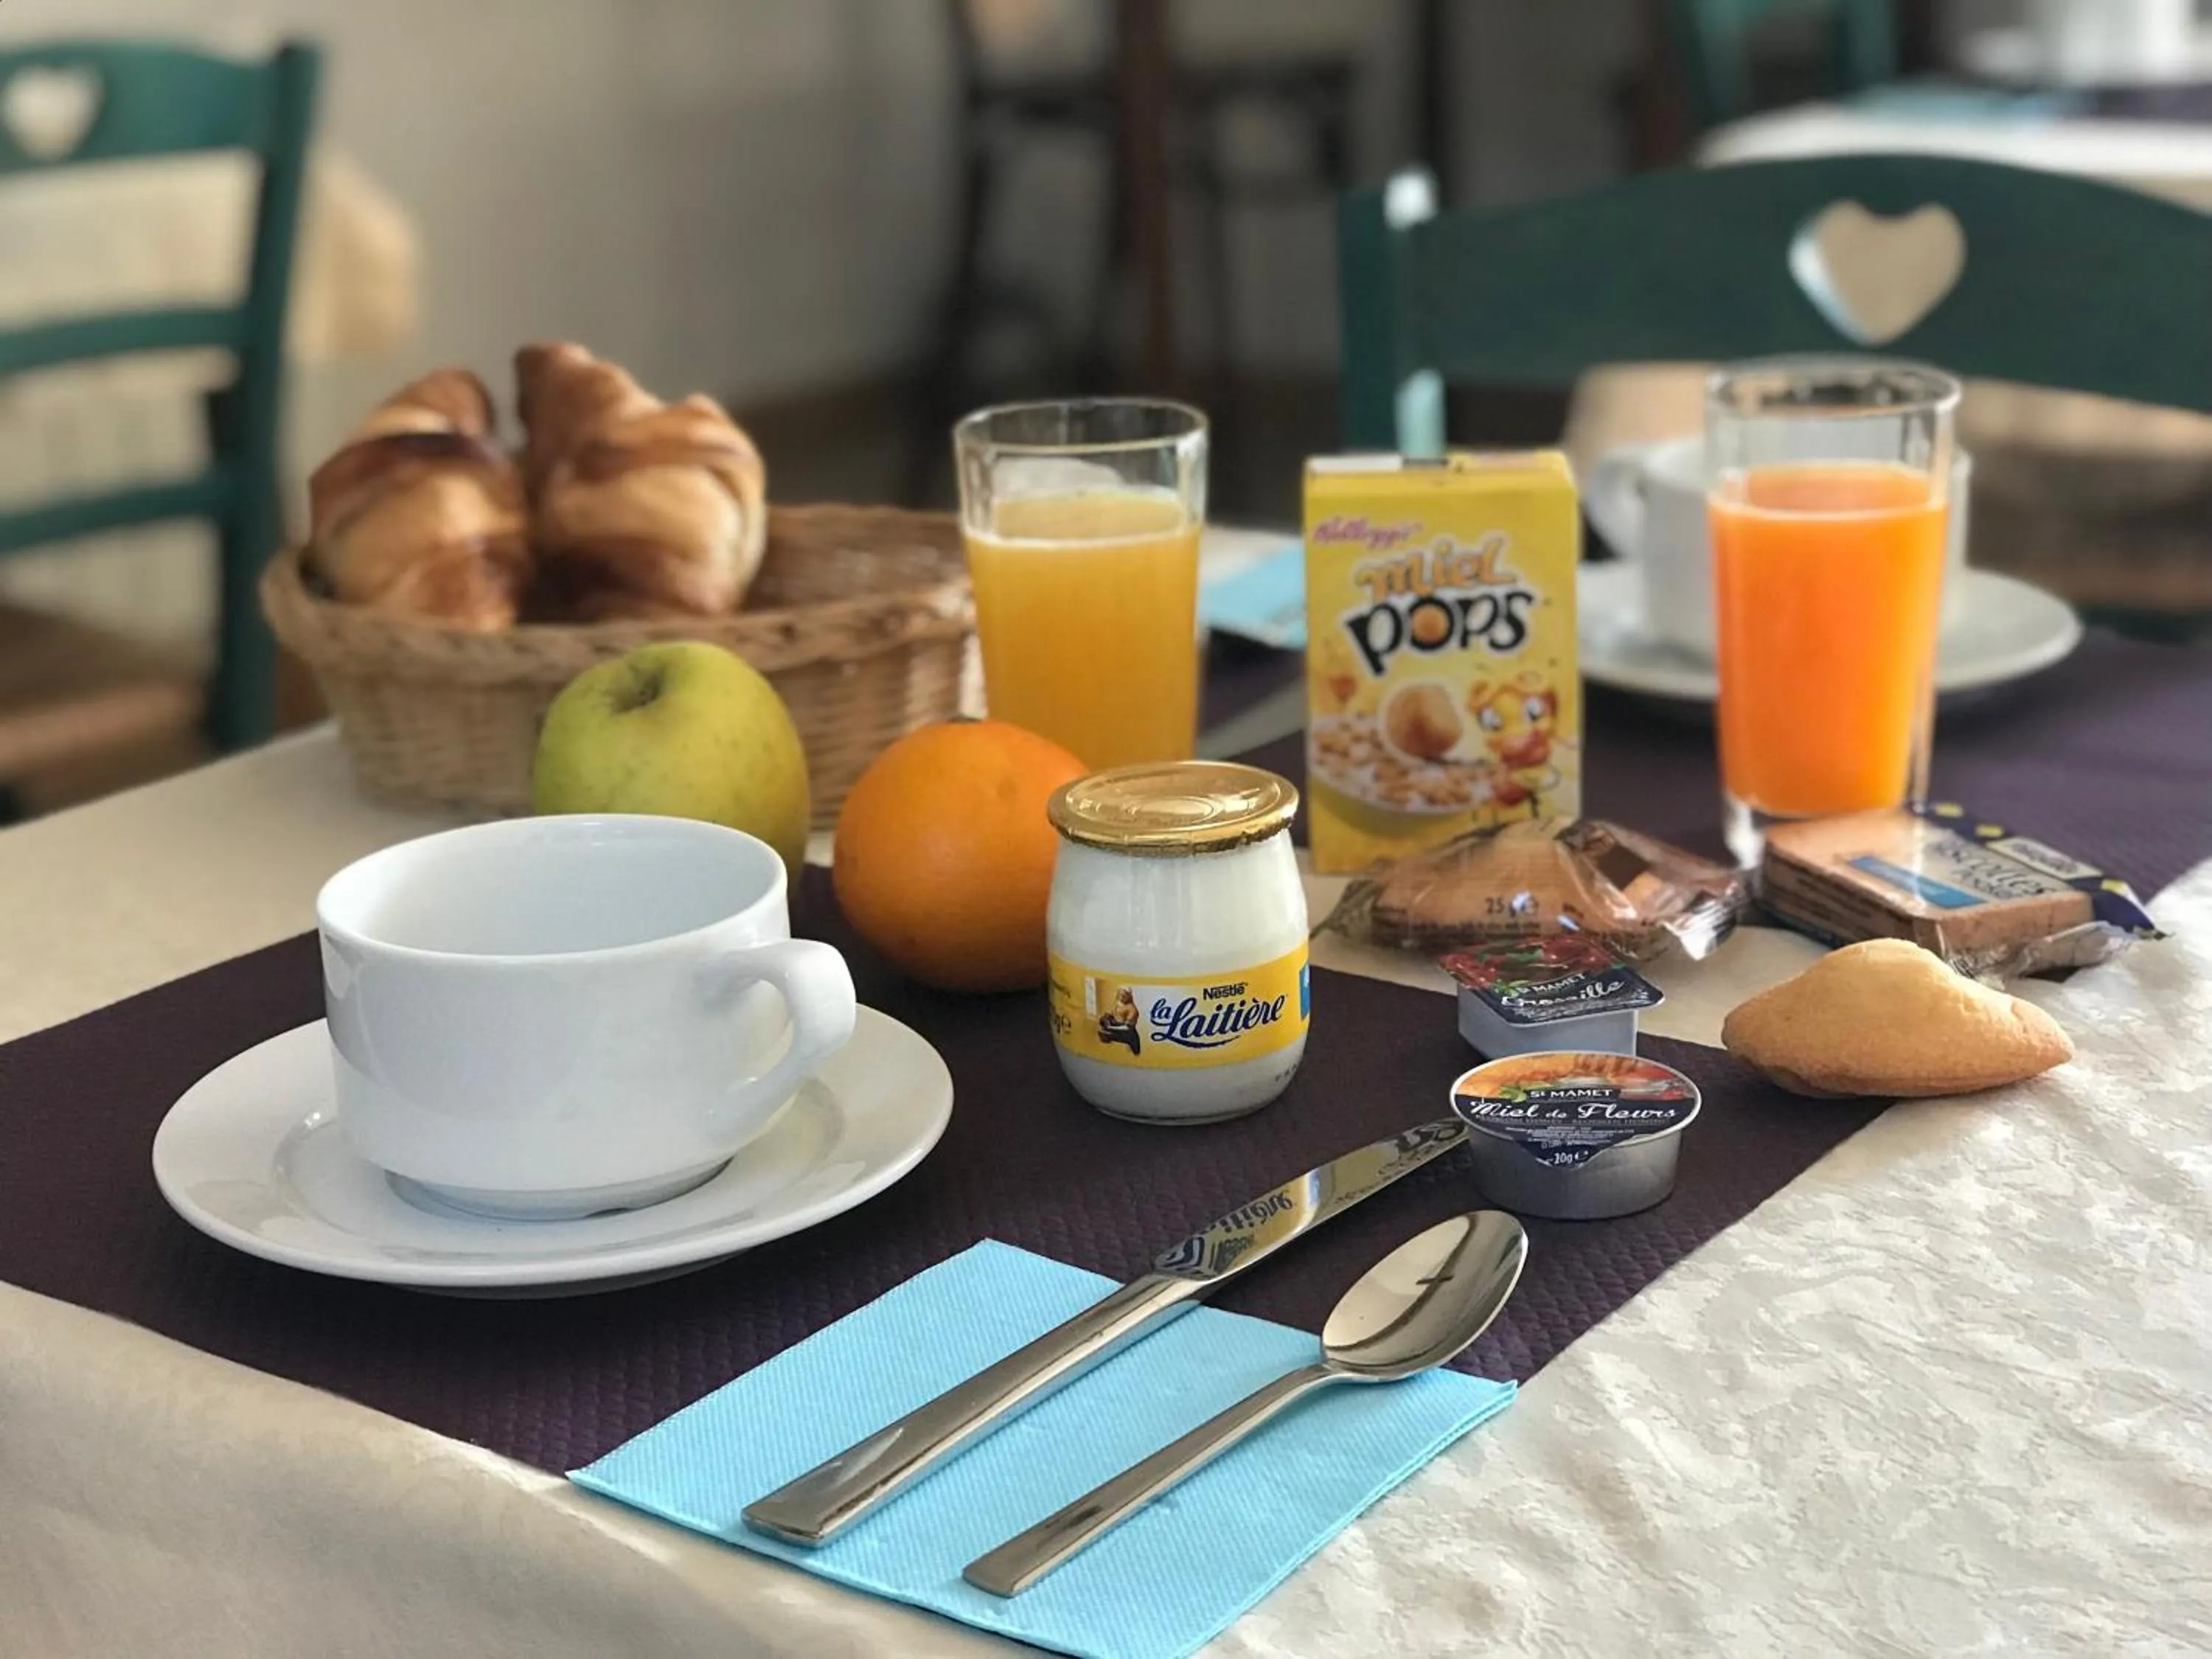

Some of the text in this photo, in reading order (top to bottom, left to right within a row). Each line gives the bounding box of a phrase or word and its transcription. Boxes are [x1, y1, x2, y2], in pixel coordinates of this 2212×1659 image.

[1203, 984, 1245, 1000] Nestlé
[1532, 973, 1586, 992] MAMET
[1151, 995, 1285, 1048] Laitière
[1551, 1089, 1613, 1098] MAMET
[1470, 1100, 1677, 1119] Miel de Fleurs
